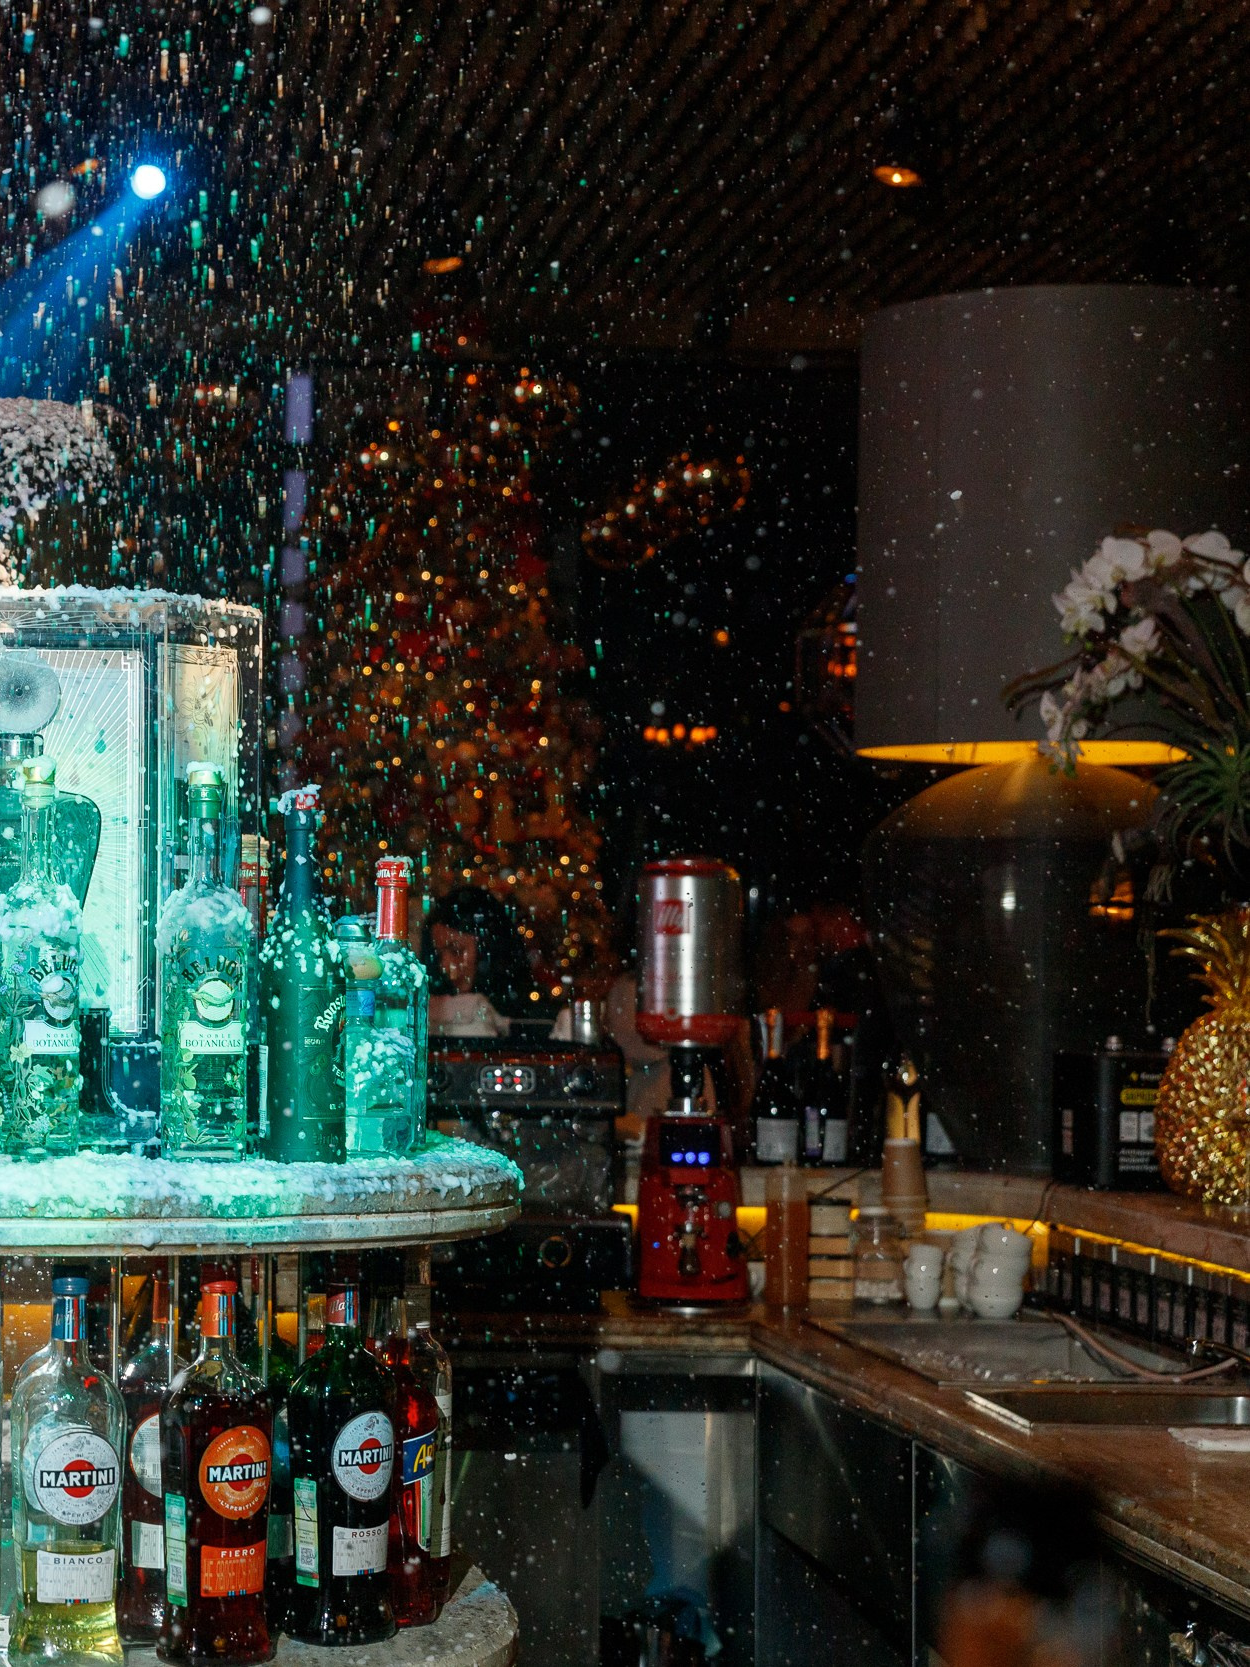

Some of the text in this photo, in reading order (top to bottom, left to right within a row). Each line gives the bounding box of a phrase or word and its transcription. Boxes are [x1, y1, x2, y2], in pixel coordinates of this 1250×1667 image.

[28, 954, 78, 983] BELUG
[181, 956, 243, 984] BELUGA
[185, 1039, 241, 1047] BOTANICALS
[341, 1445, 392, 1466] MARTINI
[42, 1468, 113, 1487] MARTINI
[209, 1461, 266, 1482] MARTINI
[352, 1529, 381, 1538] ROSSO
[53, 1557, 103, 1565] BIANCO
[221, 1548, 255, 1558] FIERO
